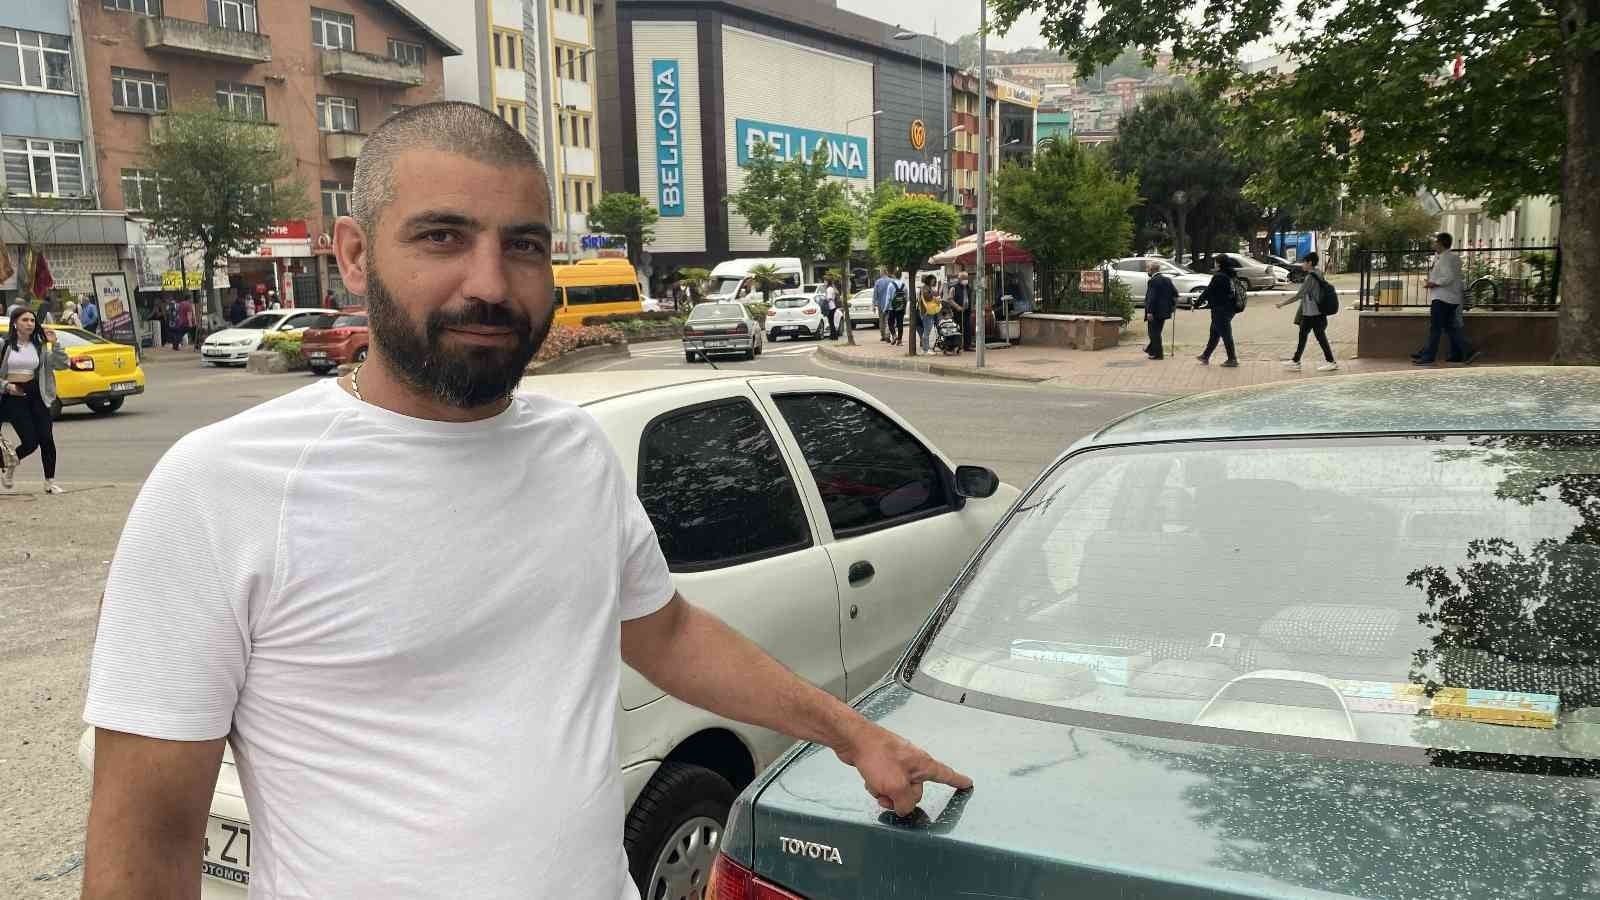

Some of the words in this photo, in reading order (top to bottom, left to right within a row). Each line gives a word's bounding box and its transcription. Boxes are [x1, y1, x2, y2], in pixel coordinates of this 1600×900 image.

[657, 67, 681, 208] BELLONA
[895, 156, 942, 185] mondi
[779, 836, 843, 865] TOYOTA
